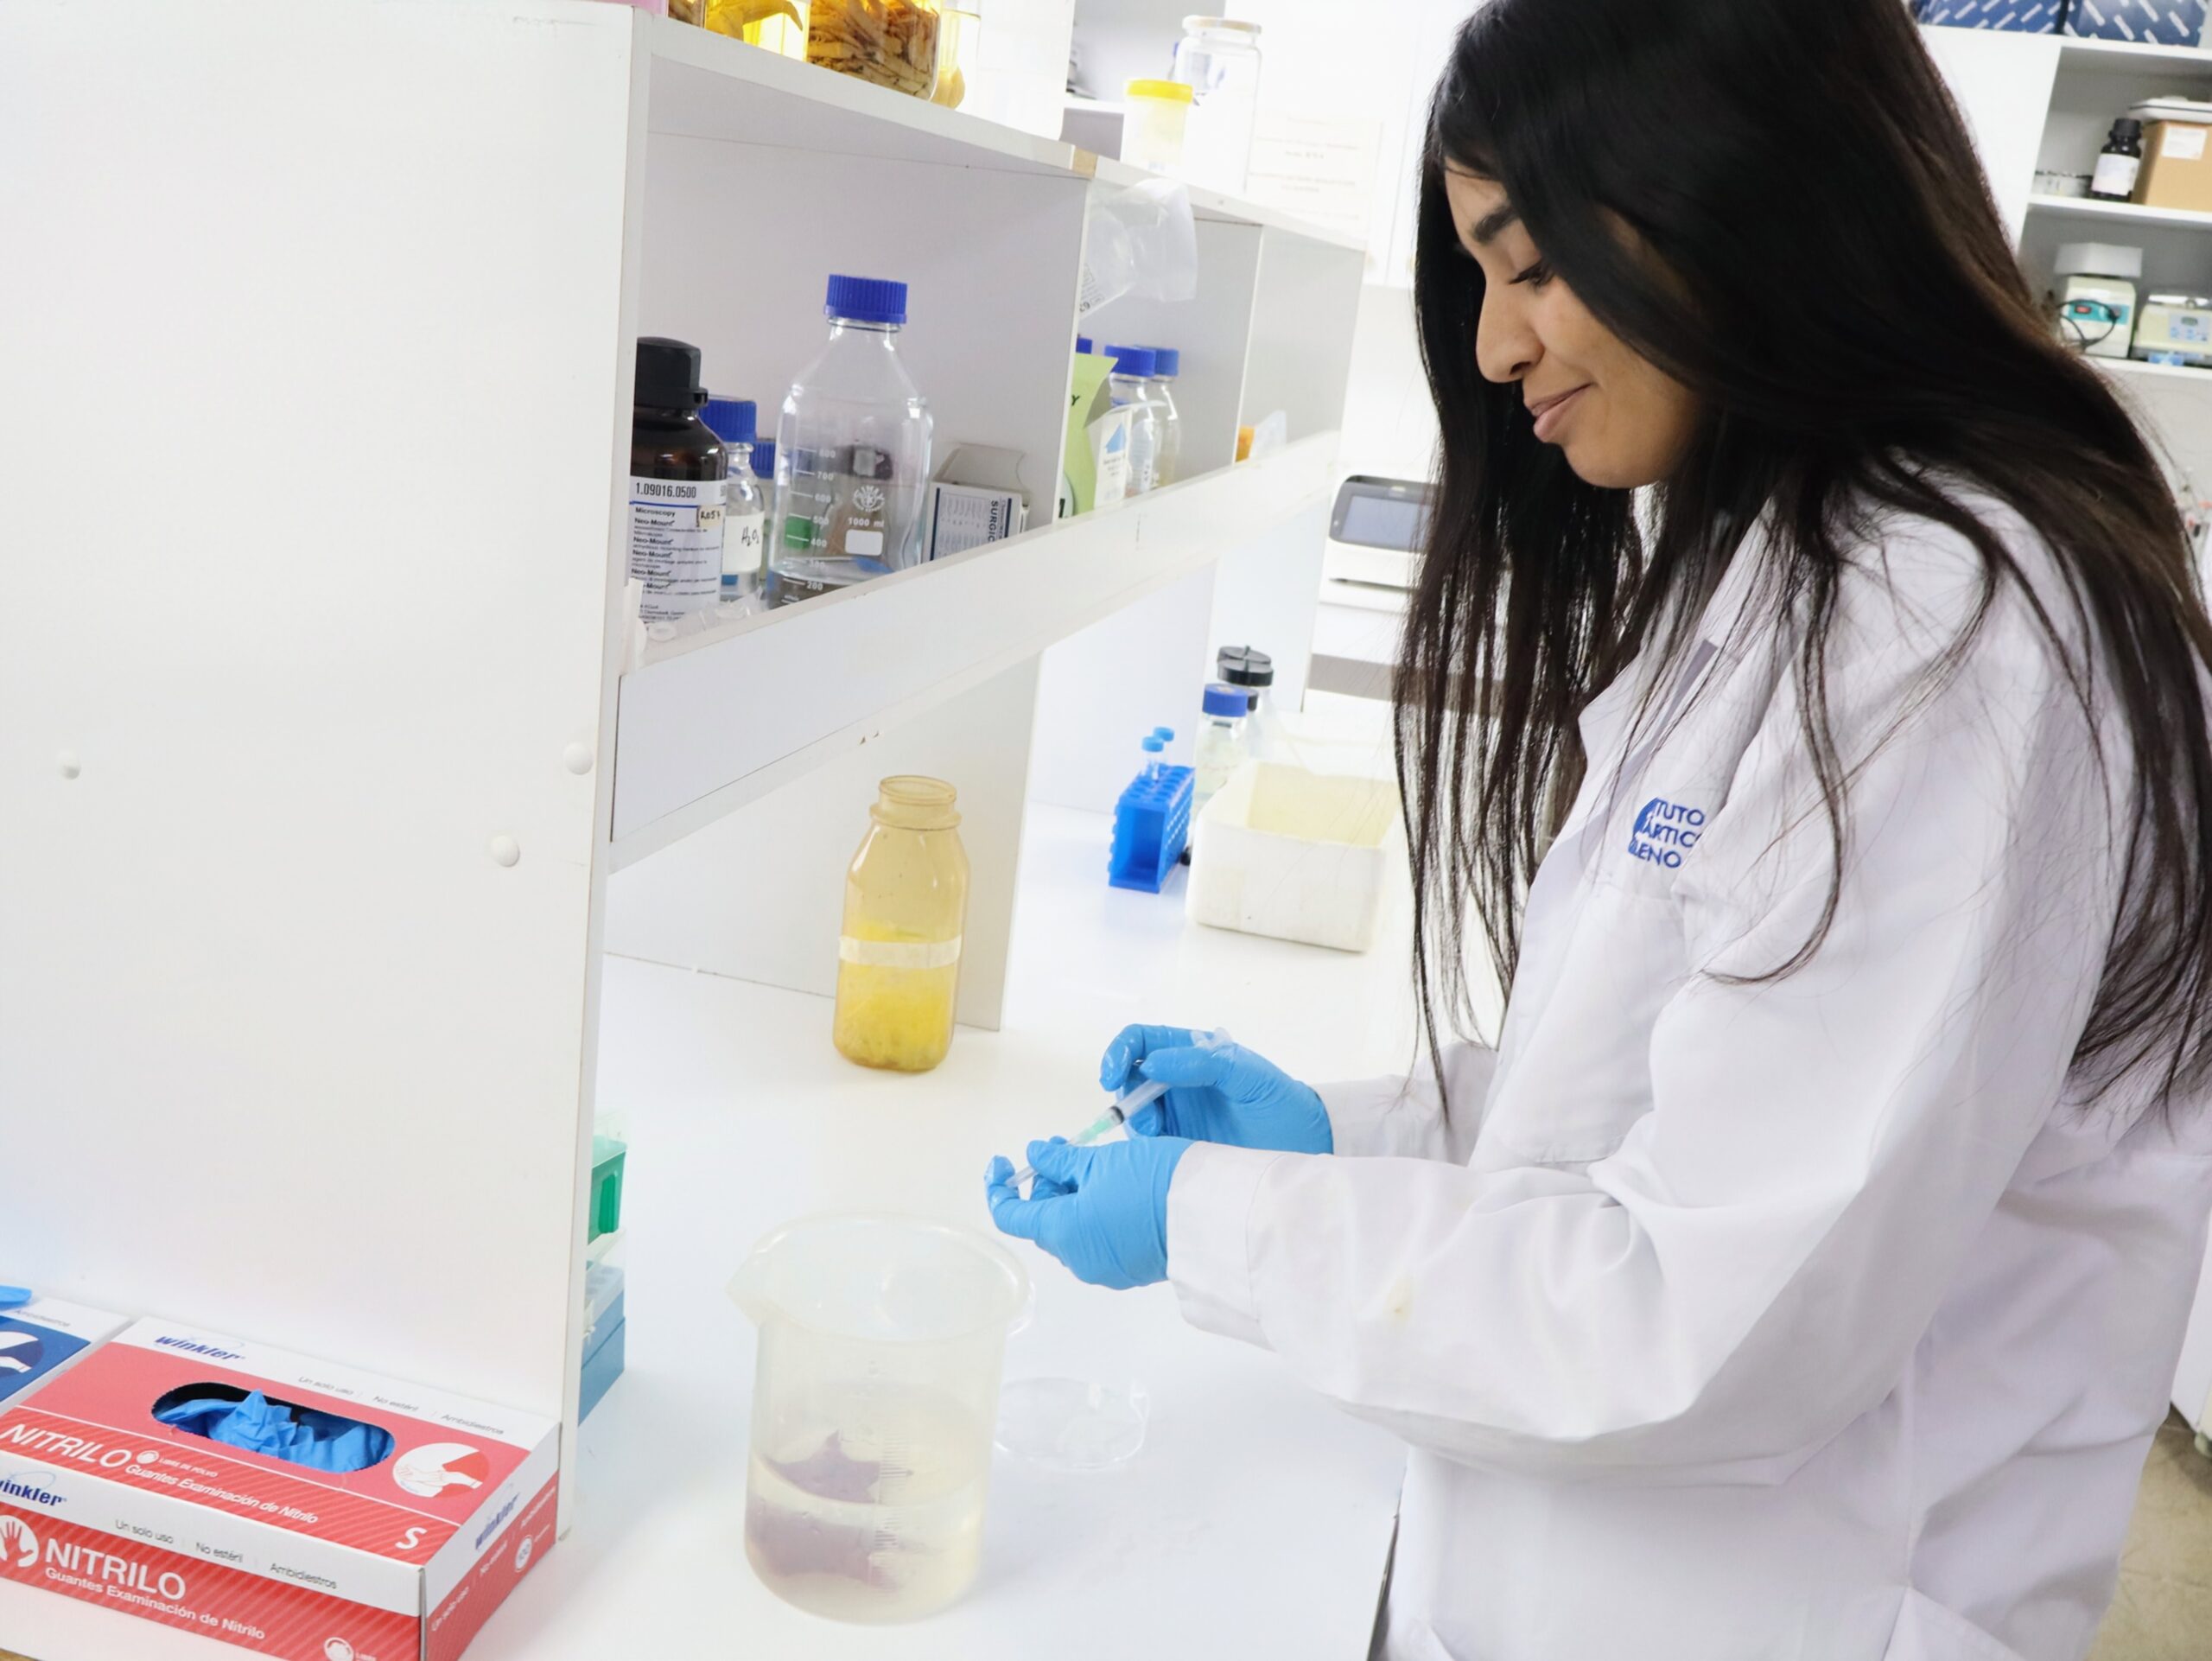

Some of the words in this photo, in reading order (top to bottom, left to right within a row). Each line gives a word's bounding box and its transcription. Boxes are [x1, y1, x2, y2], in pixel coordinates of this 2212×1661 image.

[817, 471, 834, 480] 700
[636, 482, 696, 499] 1.09016.0500
[635, 507, 676, 518] Microscopy
[849, 518, 870, 526] 1000
[807, 582, 823, 590] 200
[0, 1423, 132, 1468] NITRILO
[126, 1463, 178, 1486] Guantes
[178, 1478, 259, 1508] Examinación
[259, 1502, 279, 1514] de
[279, 1505, 320, 1524] Nitrilo
[115, 1519, 130, 1530] Un
[132, 1524, 153, 1538] solo
[155, 1531, 174, 1544] uso
[395, 1526, 428, 1550] S
[196, 1542, 211, 1554] No
[46, 1538, 186, 1600] NITRILO
[270, 1562, 337, 1589] Ambidiestros
[45, 1567, 103, 1594] Guantes
[106, 1584, 197, 1620] Examinación
[200, 1613, 219, 1626] de
[222, 1618, 265, 1639] Nitrilo
